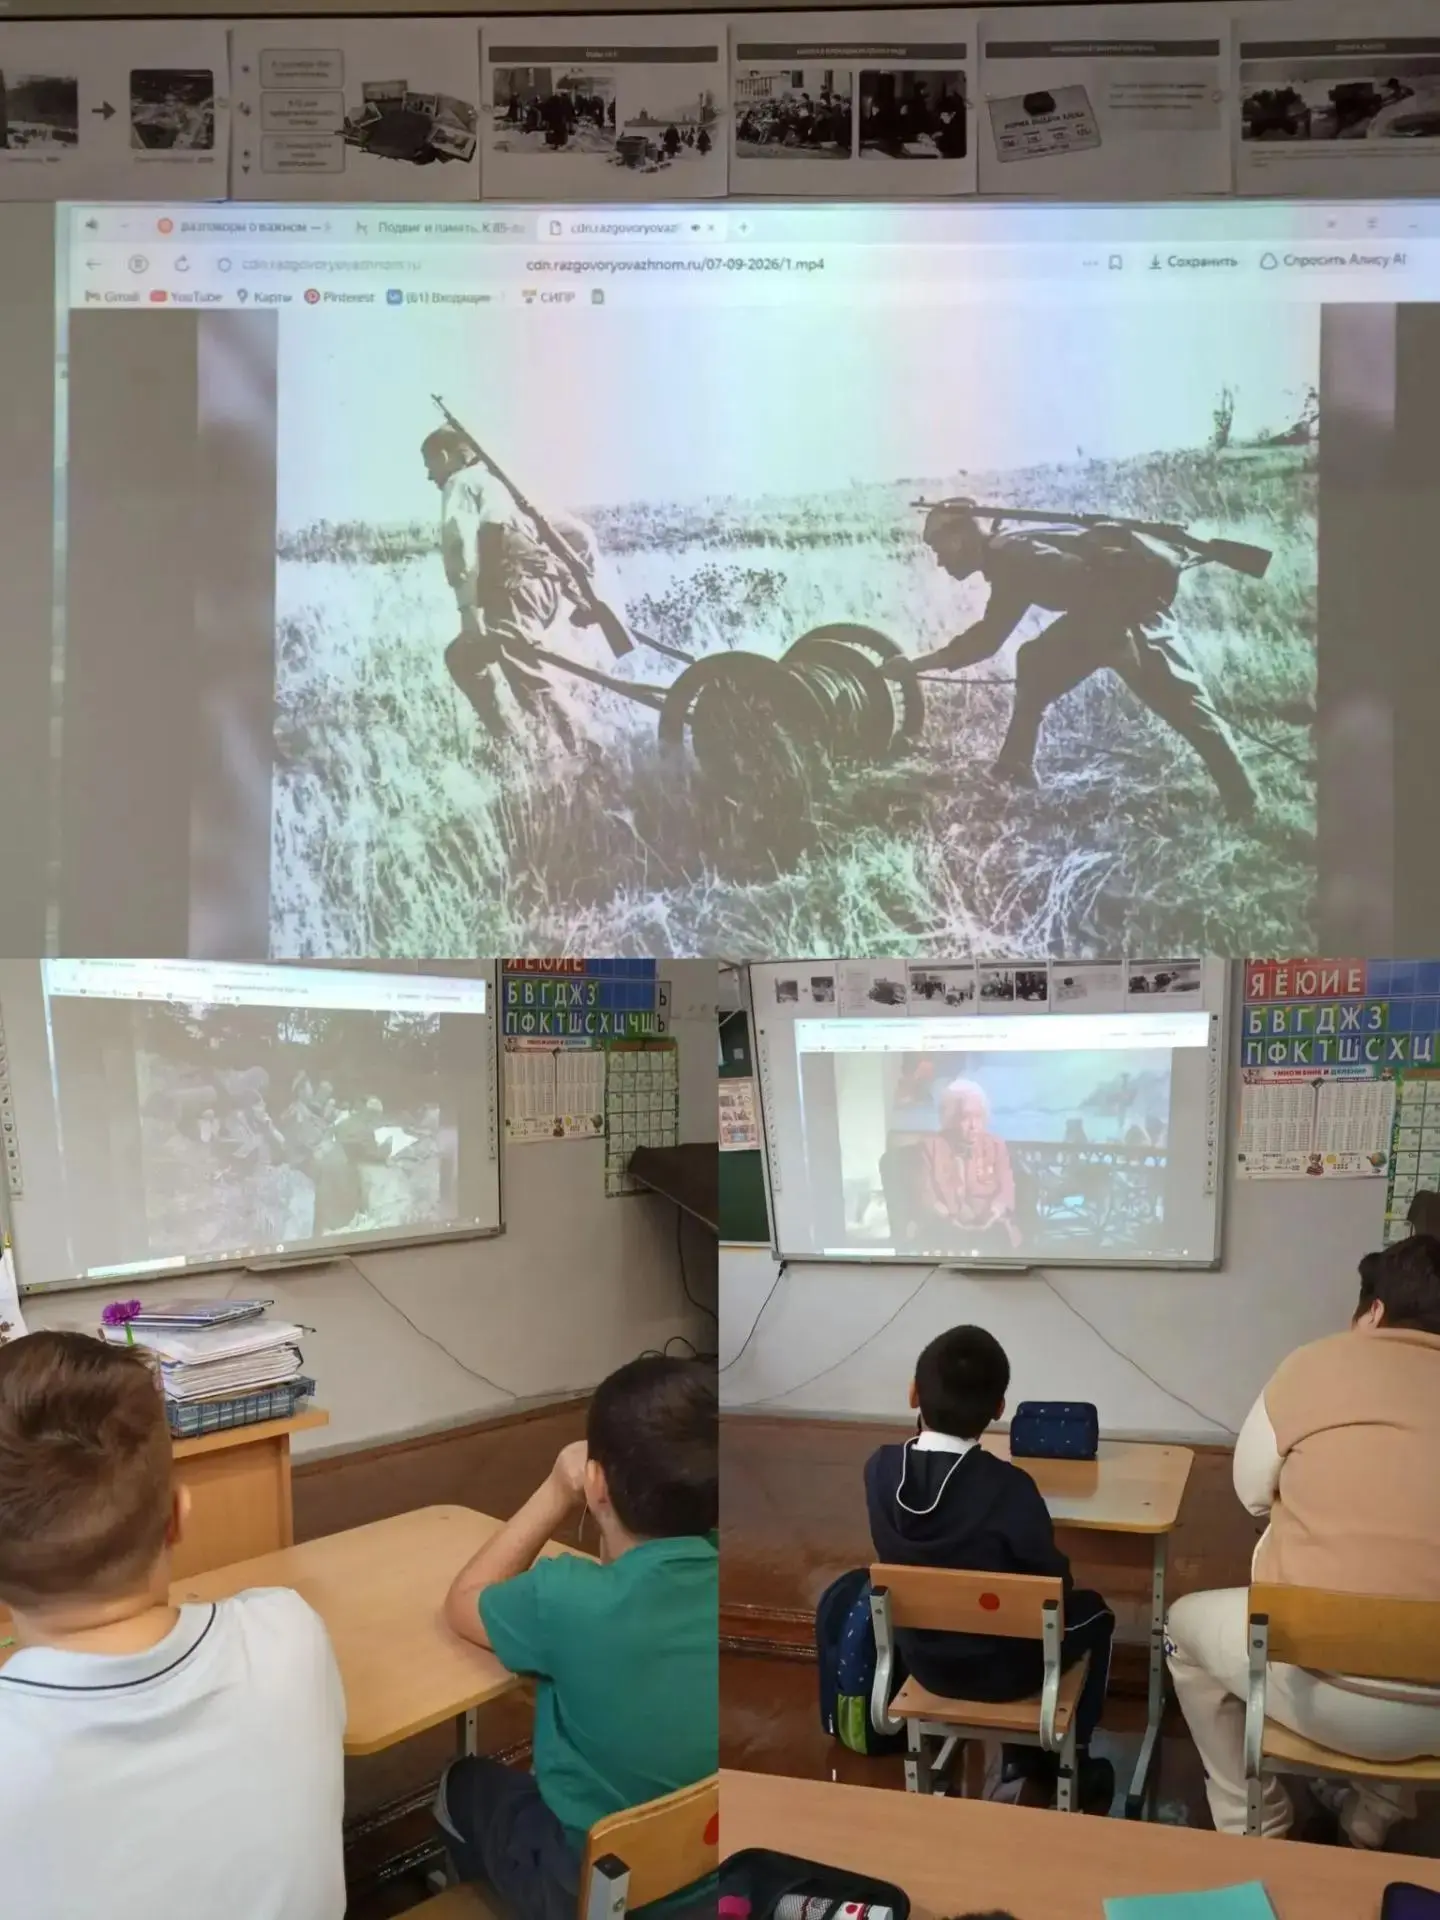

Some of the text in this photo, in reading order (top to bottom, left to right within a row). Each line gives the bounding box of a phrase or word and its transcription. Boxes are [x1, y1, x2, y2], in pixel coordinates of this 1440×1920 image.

[378, 221, 421, 236] Подвиг
[424, 223, 433, 233] и
[526, 257, 825, 275] cdn.razgovoryovazhnom.ru/07-09-2026/1.mp4
[1167, 254, 1238, 269] Сохранить
[1283, 254, 1346, 268] Спросить
[1350, 254, 1389, 268] Алису
[104, 290, 140, 302] Gmail
[171, 290, 223, 302] YouTube
[254, 291, 293, 304] Карты
[323, 291, 376, 303] Pinterest
